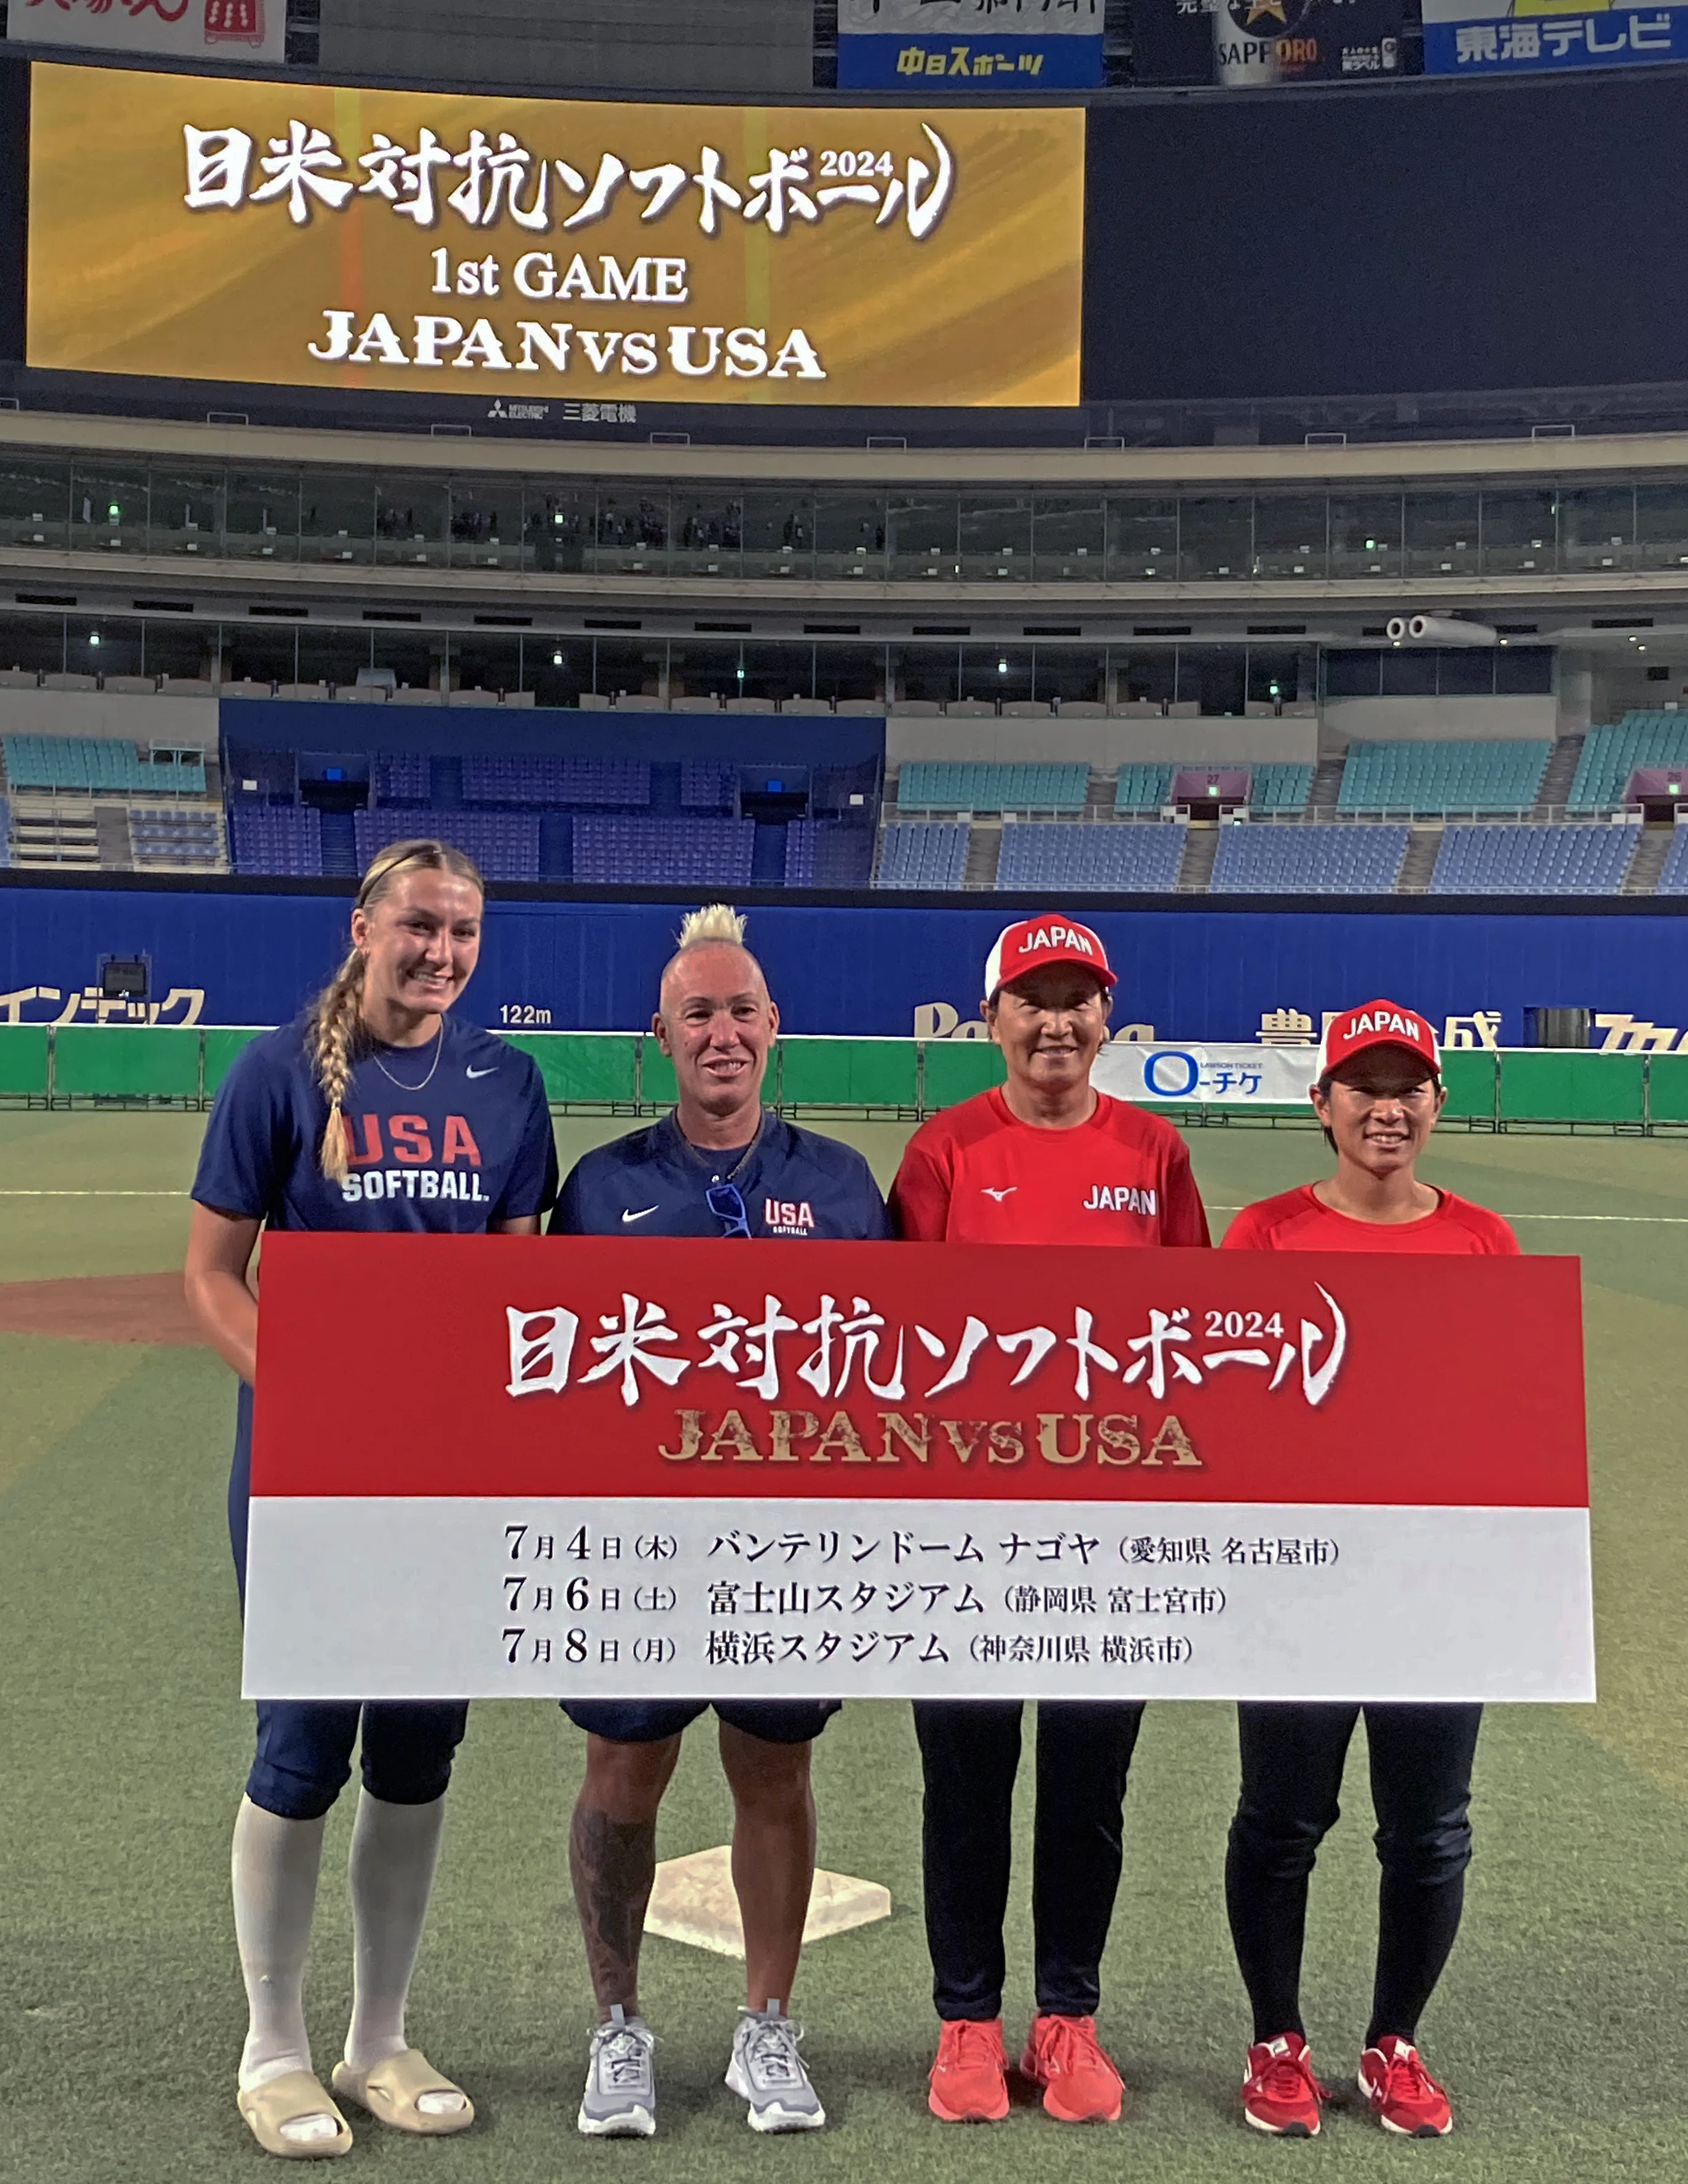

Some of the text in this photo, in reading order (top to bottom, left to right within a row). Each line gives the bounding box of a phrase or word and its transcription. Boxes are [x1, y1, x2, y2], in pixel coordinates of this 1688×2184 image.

[1218, 38, 1317, 66] SAPPORO
[1456, 14, 1671, 63] 東海テレビ
[897, 47, 1044, 76] 中日スポーツ
[184, 120, 953, 239] 日米対抗ソフトボール 2024
[432, 248, 688, 302] 1st GAME
[308, 310, 572, 372] JAPAN
[668, 327, 826, 379] USA
[1207, 774, 1220, 785] 27
[1667, 771, 1682, 782] 26
[1018, 926, 1092, 956] JAPAN
[500, 1004, 551, 1024] 122m
[1343, 1011, 1419, 1041] JAPAN
[342, 1114, 481, 1166] USA
[342, 1170, 484, 1202] SOFTBALL
[1083, 1185, 1156, 1216] JAPAN
[765, 1198, 814, 1227] USA
[506, 1281, 1346, 1406] 日米対抗ソフトボール 2024
[658, 1409, 932, 1463] JAPAN
[1036, 1413, 1202, 1467] USA
